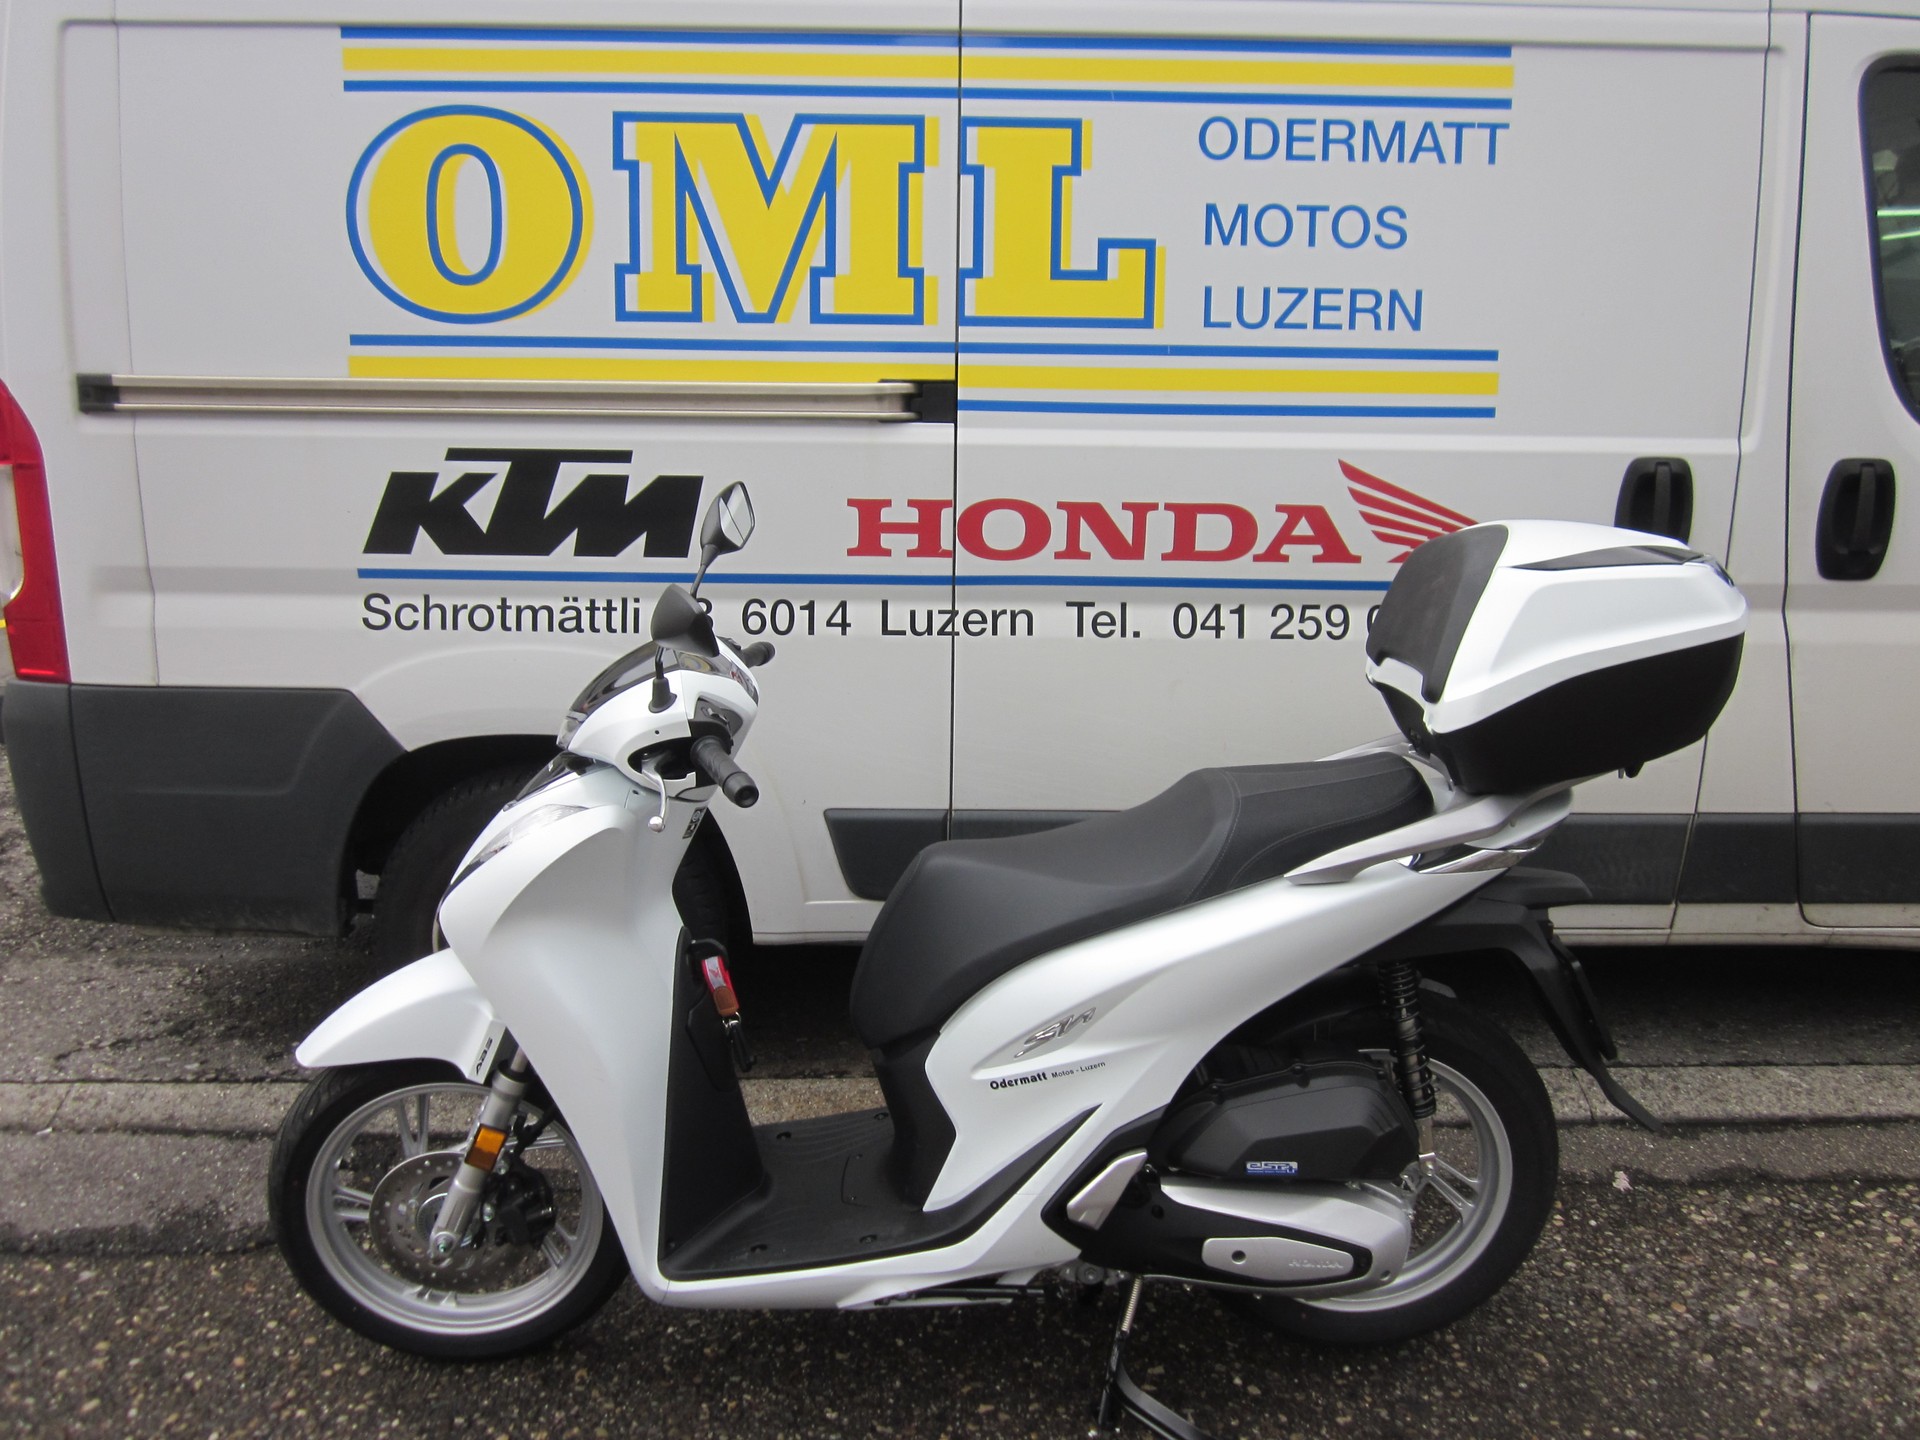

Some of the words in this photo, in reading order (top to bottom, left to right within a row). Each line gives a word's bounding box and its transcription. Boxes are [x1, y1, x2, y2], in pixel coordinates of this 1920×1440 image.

[1198, 115, 1511, 165] ODERMATT
[346, 104, 1163, 328] OML
[1203, 202, 1408, 249] MOTOS
[1202, 285, 1424, 331] LUZERN
[362, 447, 704, 558] KTM
[846, 498, 1362, 563] HONDA
[361, 592, 641, 634] Schrotmättli
[741, 598, 852, 636] 6014
[880, 599, 1035, 637] Luzern
[1066, 601, 1141, 638] Tel.
[1172, 602, 1246, 639] 041
[1270, 604, 1351, 640] 259
[989, 1071, 1048, 1090] Odermatt
[1051, 1068, 1075, 1079] Motos
[1080, 1061, 1107, 1073] Luzern
